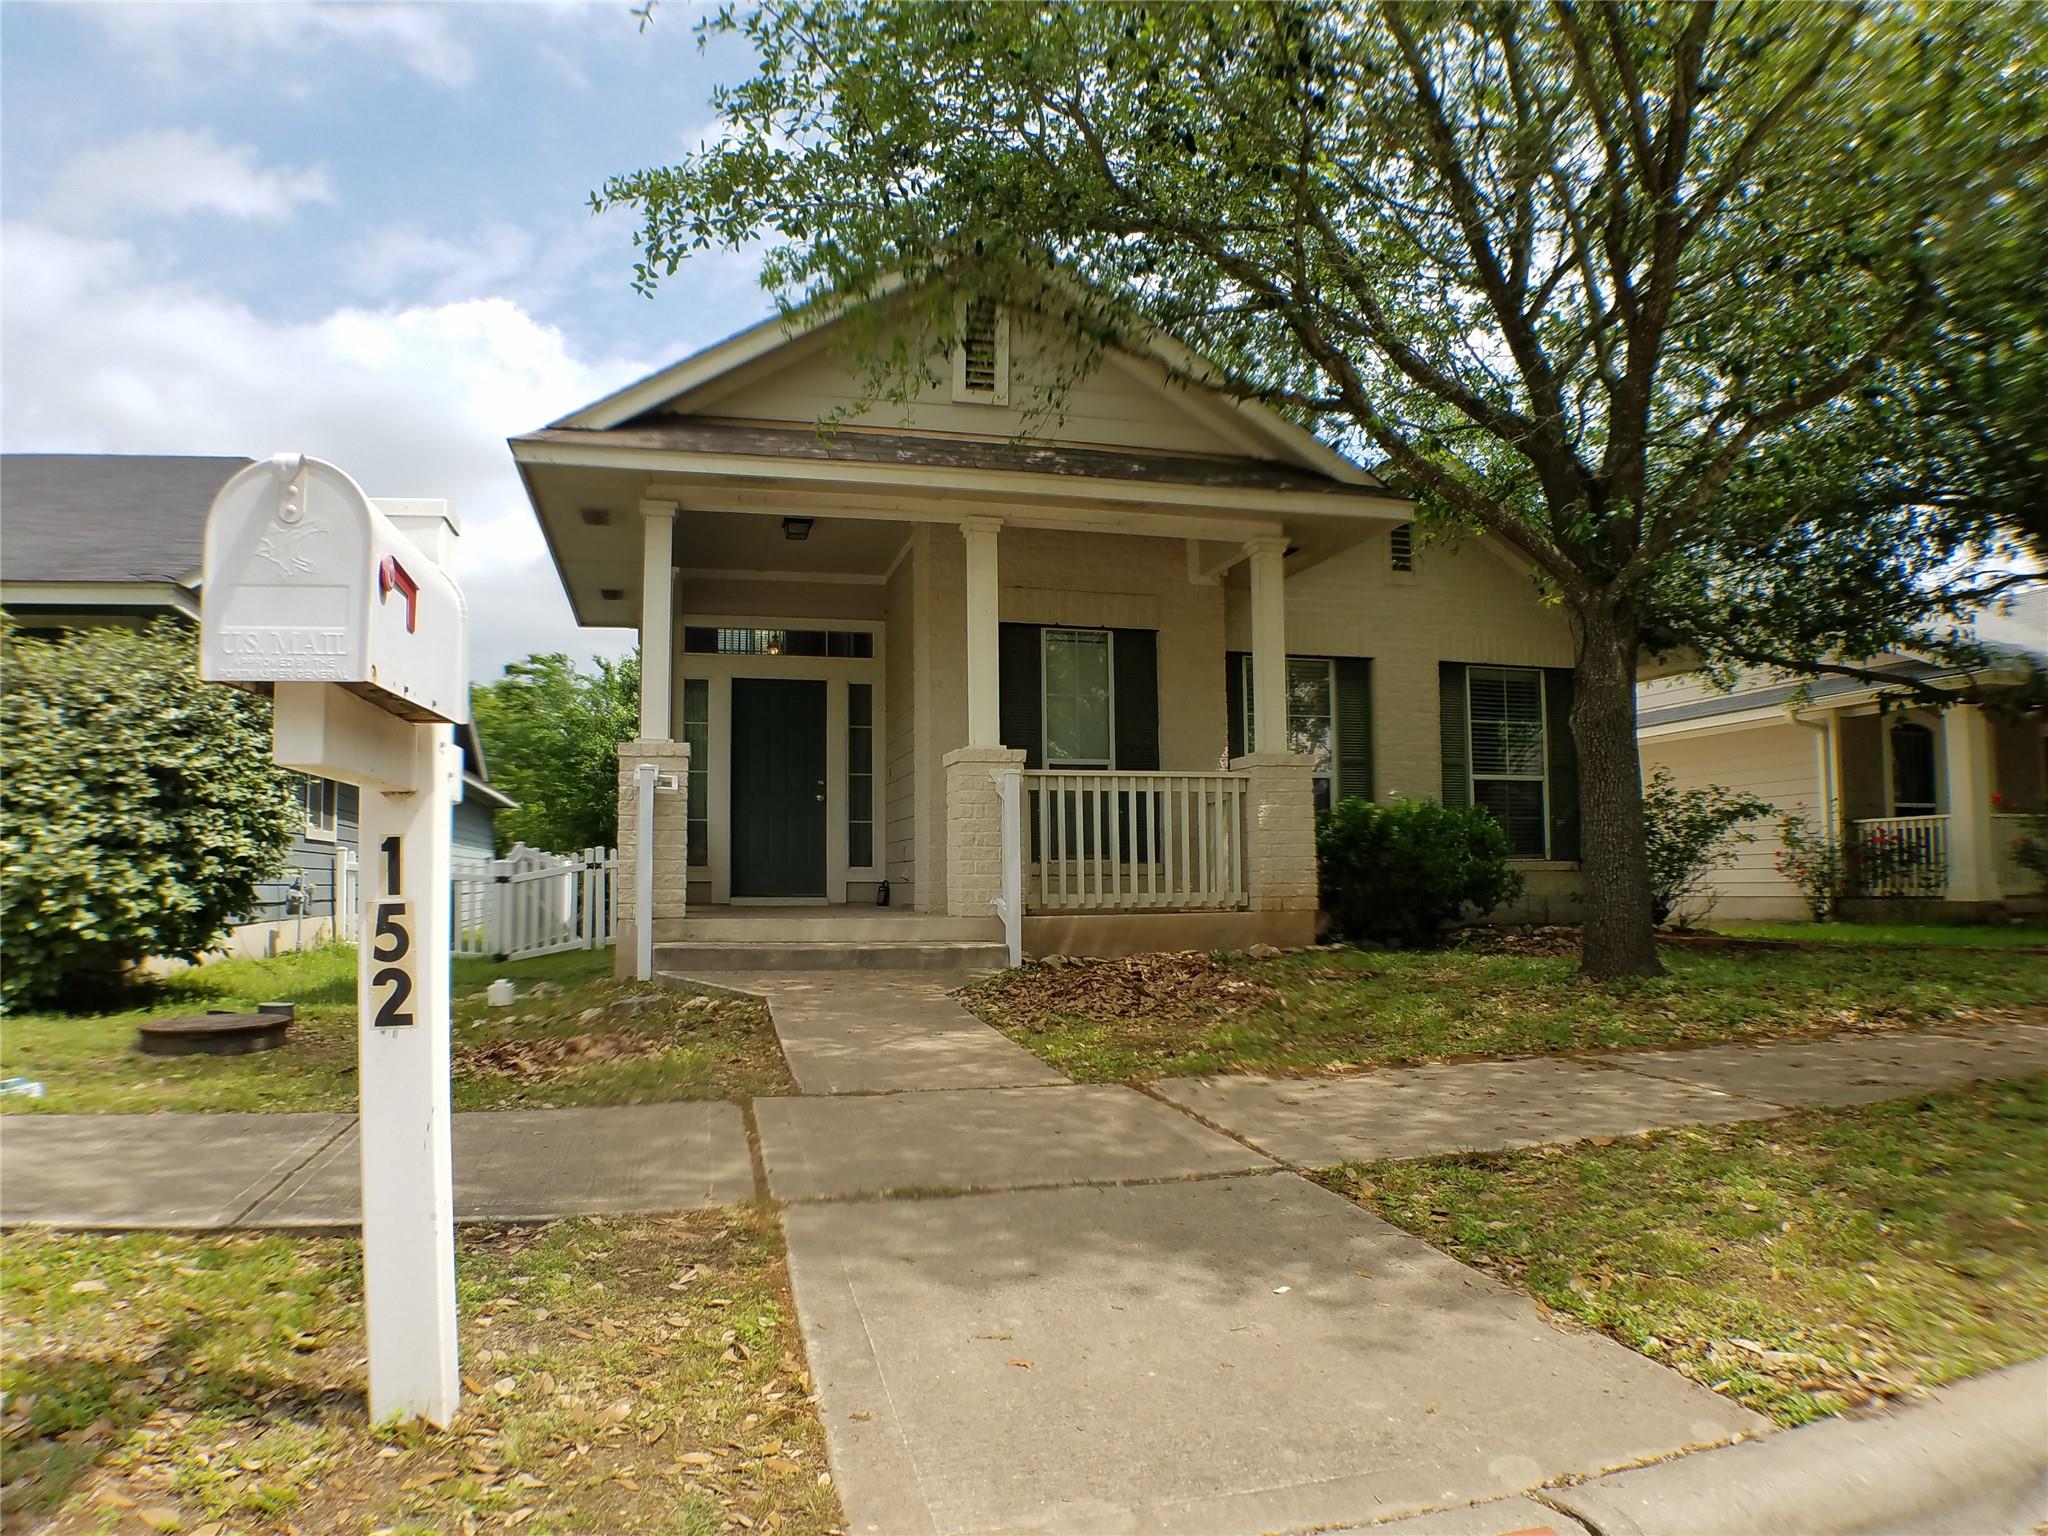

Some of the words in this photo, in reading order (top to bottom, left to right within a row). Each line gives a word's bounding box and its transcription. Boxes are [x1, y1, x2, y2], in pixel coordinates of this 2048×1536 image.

[218, 631, 263, 655] U.S.
[271, 631, 348, 656] MAIL
[296, 669, 349, 681] GENERAL
[373, 837, 413, 1027] 152
